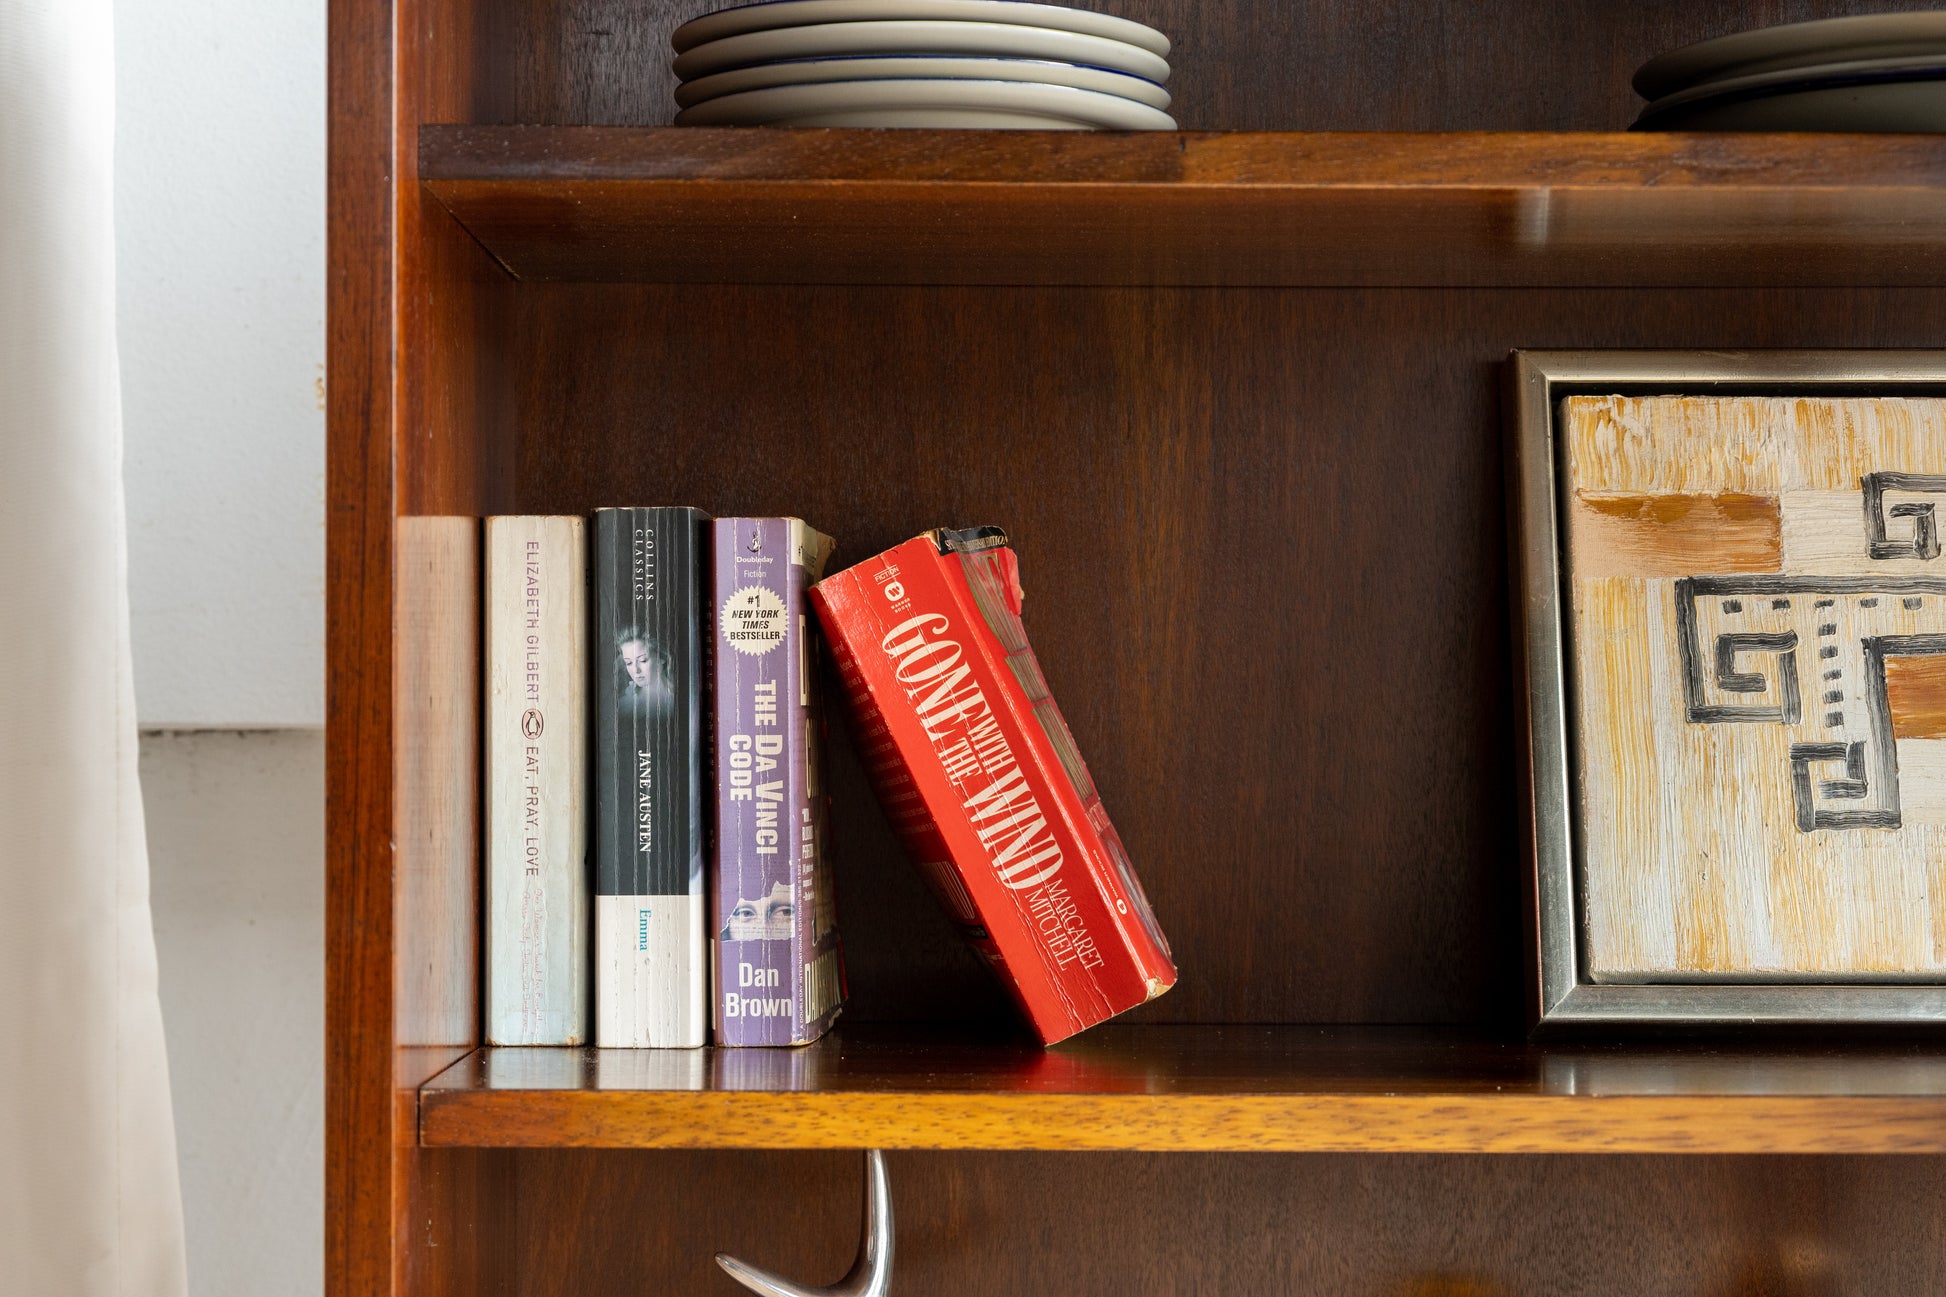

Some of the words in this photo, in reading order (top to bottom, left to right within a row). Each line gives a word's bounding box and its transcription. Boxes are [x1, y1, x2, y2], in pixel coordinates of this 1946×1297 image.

[635, 529, 644, 600] CLASSICS
[645, 529, 654, 600] COLLINS
[736, 556, 774, 564] Doubleday
[743, 569, 767, 578] Fiction
[874, 566, 900, 582] FICTION
[526, 541, 539, 629] ELIZABETH
[747, 595, 761, 608] #1
[730, 631, 780, 640] BESTSELLER
[731, 609, 753, 619] NEW
[755, 609, 780, 619] YORK
[742, 620, 770, 629] TIMES
[526, 635, 539, 702] GILBERT
[881, 613, 992, 743] GONE
[754, 679, 777, 726] THE
[524, 746, 539, 779] EAT,
[755, 734, 783, 773] DA
[938, 737, 983, 787] THE
[967, 714, 1016, 775] WITH
[638, 750, 652, 789] JANE
[729, 734, 752, 801] CODE
[524, 786, 539, 831] PRAY,
[639, 791, 652, 853] AUSTEN
[755, 780, 783, 854] VINCI
[963, 764, 1064, 890] WIND
[525, 837, 539, 877] LOVE
[639, 908, 652, 951] Emma
[1025, 887, 1078, 972] MITCHELL
[1045, 878, 1105, 970] MARGARET
[738, 963, 779, 987] Dan
[725, 992, 792, 1018] Brown
